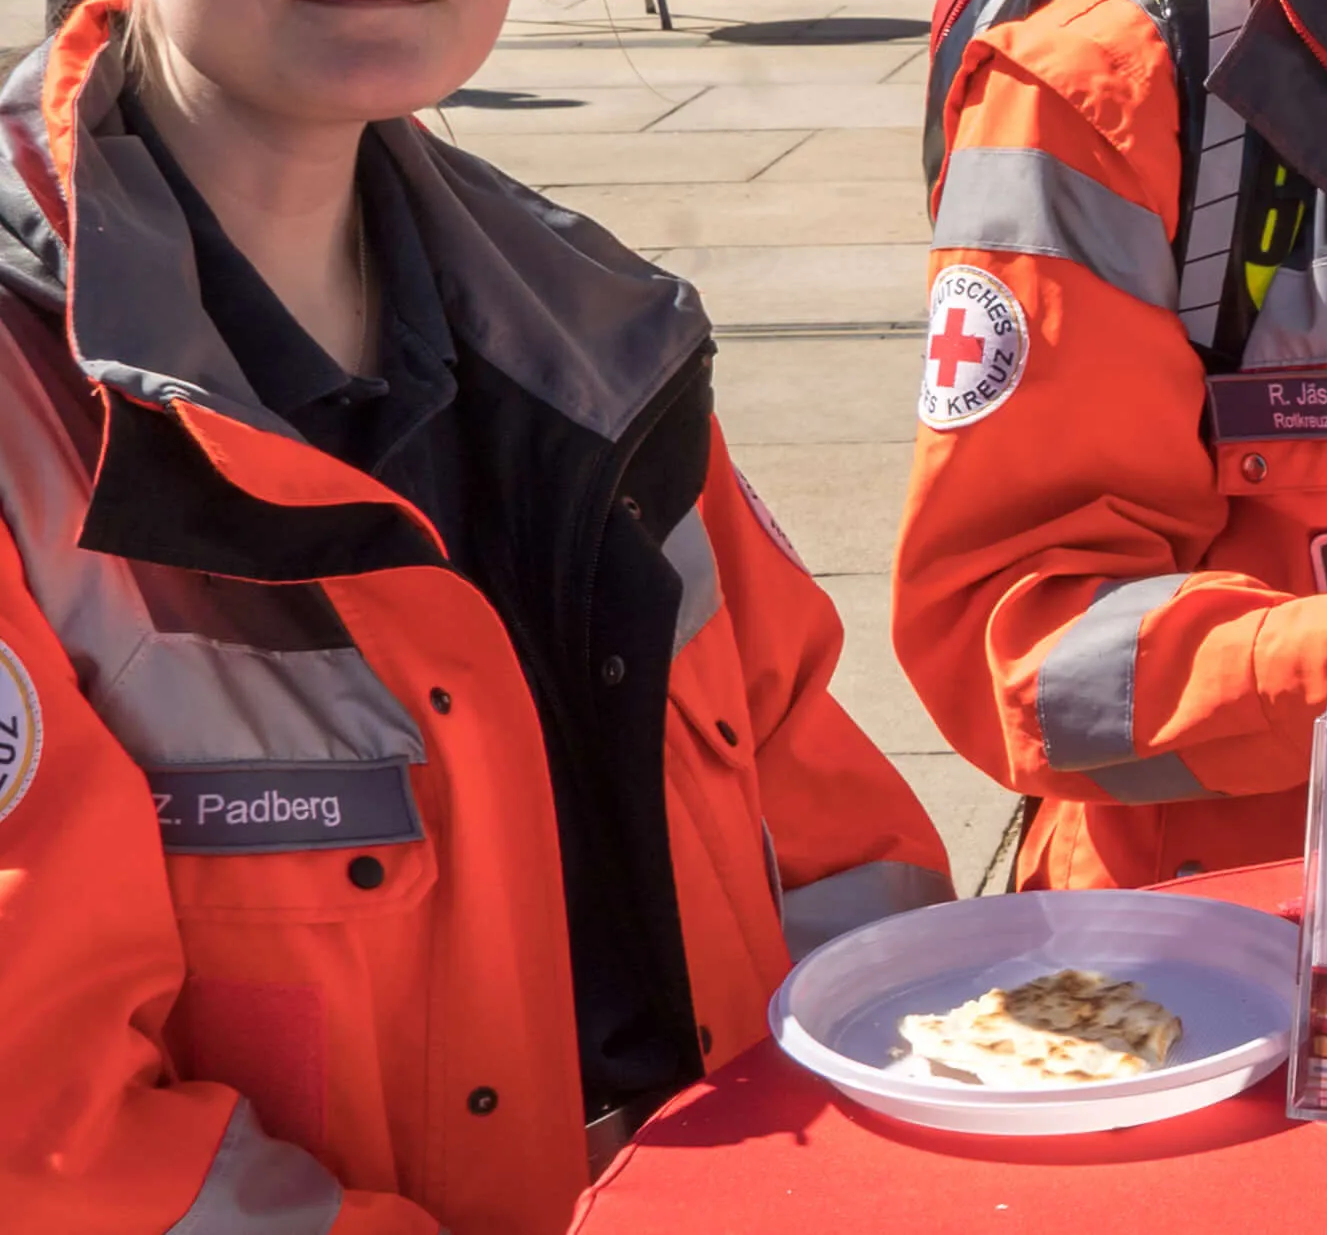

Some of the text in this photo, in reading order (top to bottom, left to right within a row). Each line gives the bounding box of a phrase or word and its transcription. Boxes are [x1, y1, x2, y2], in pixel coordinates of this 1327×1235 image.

[947, 348, 1015, 417] KREUZ
[1269, 382, 1291, 406] R.
[197, 789, 343, 827] Padberg
